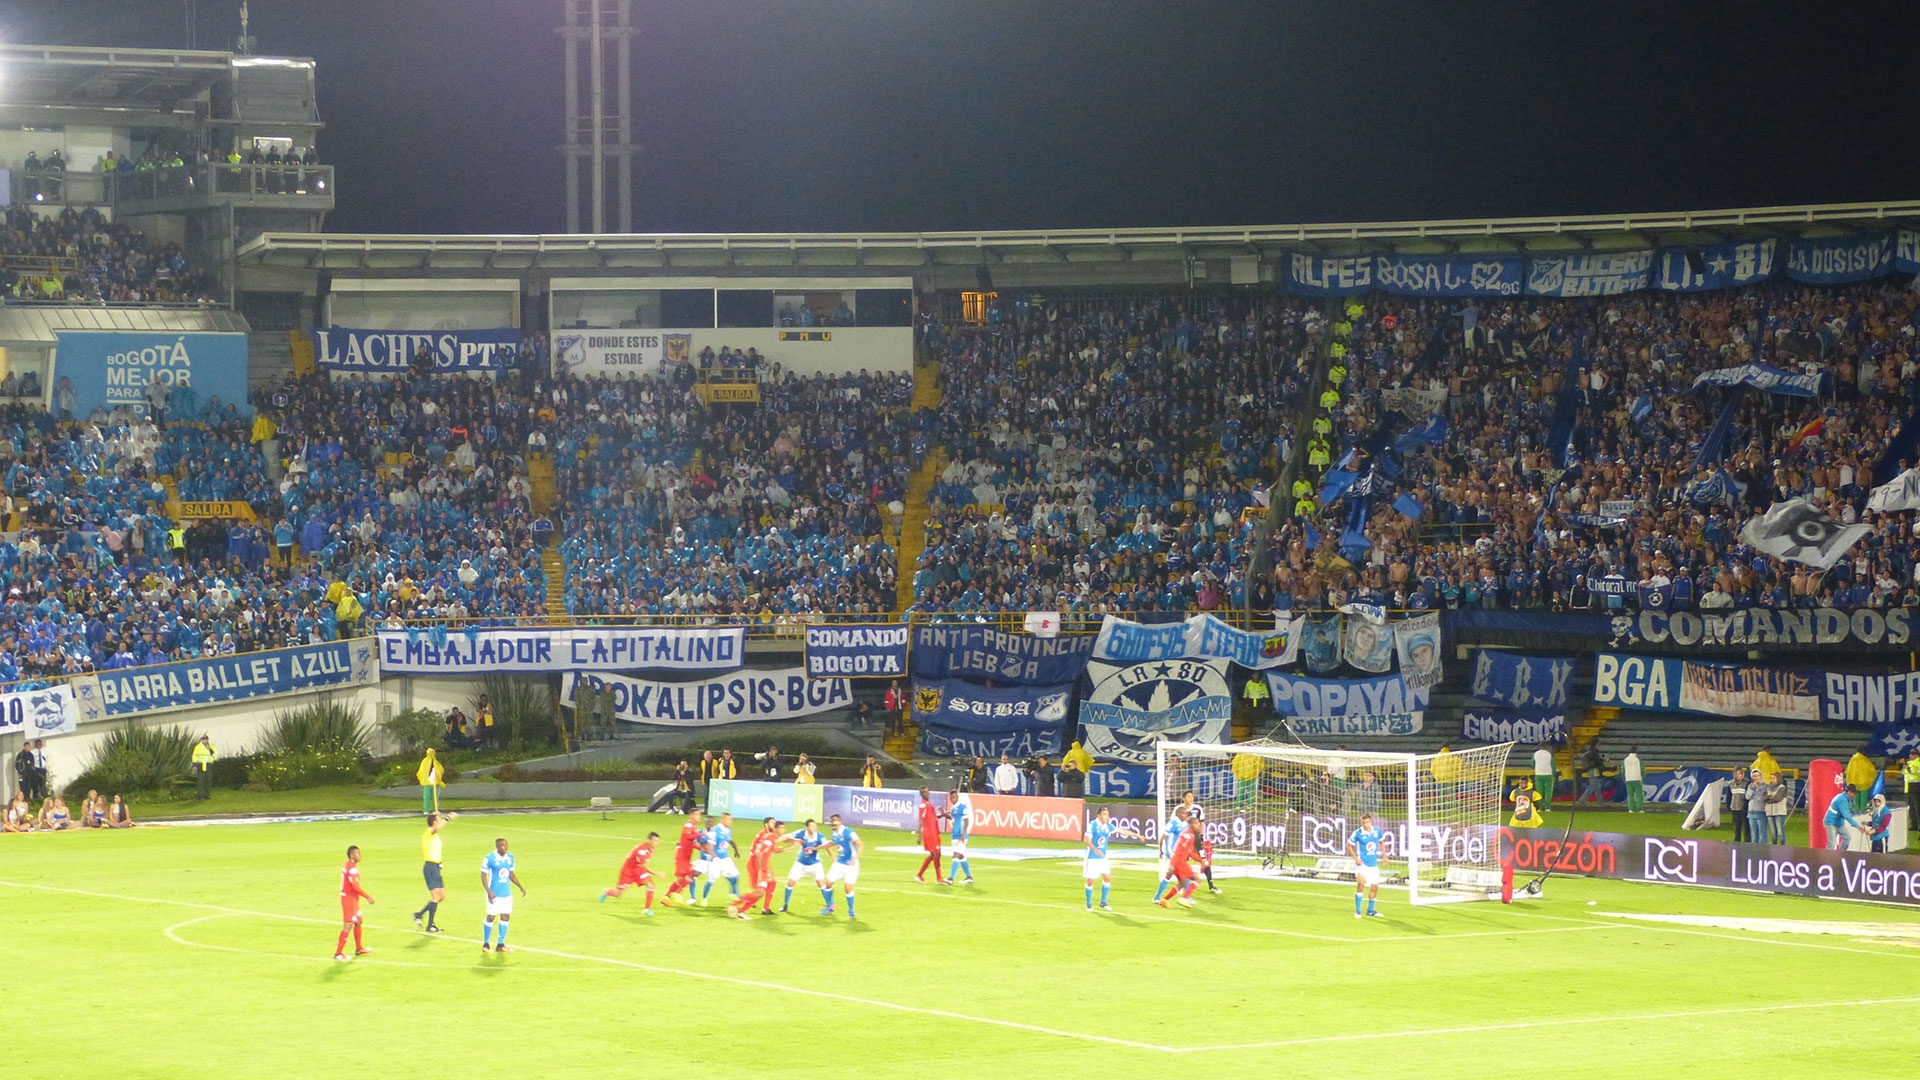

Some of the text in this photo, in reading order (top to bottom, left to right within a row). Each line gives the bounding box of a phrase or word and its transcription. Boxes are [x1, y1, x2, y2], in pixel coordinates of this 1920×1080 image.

[1291, 253, 1371, 289] ALPES
[1564, 249, 1655, 277] LUCERO
[106, 336, 192, 367] BOGOTÁ
[316, 331, 457, 368] LACHES
[589, 335, 659, 349] DONDE ESTES
[605, 352, 643, 365] ESTARE
[106, 367, 192, 388] MEJOR
[106, 387, 141, 398] PARA
[716, 390, 752, 400] SALIDA
[185, 503, 231, 516] SALIDA
[806, 626, 908, 648] COMANDO
[1638, 607, 1911, 646] COMANDOS
[386, 635, 734, 666] EMBAJADOR CAPITALINO
[920, 627, 1093, 657] ANTI-PROVINCIA
[102, 649, 350, 705] BARRA BALLET AZUL
[811, 654, 900, 674] BOGOTA
[1117, 666, 1149, 688] LA
[1266, 672, 1430, 717] POPAYAN
[1594, 655, 1669, 708] BGA
[948, 697, 1032, 719] SUBA
[1464, 712, 1565, 744] GIRARDOT
[872, 799, 912, 815] NOTICIAS
[974, 808, 1081, 832] DAVIVIENDA
[1232, 816, 1247, 846] 9
[1251, 824, 1287, 852] pm
[1399, 824, 1452, 860] LEY
[1452, 827, 1487, 863] del
[1492, 827, 1616, 874] Corazón
[1731, 849, 1810, 889] Lunes
[1817, 864, 1835, 891] a
